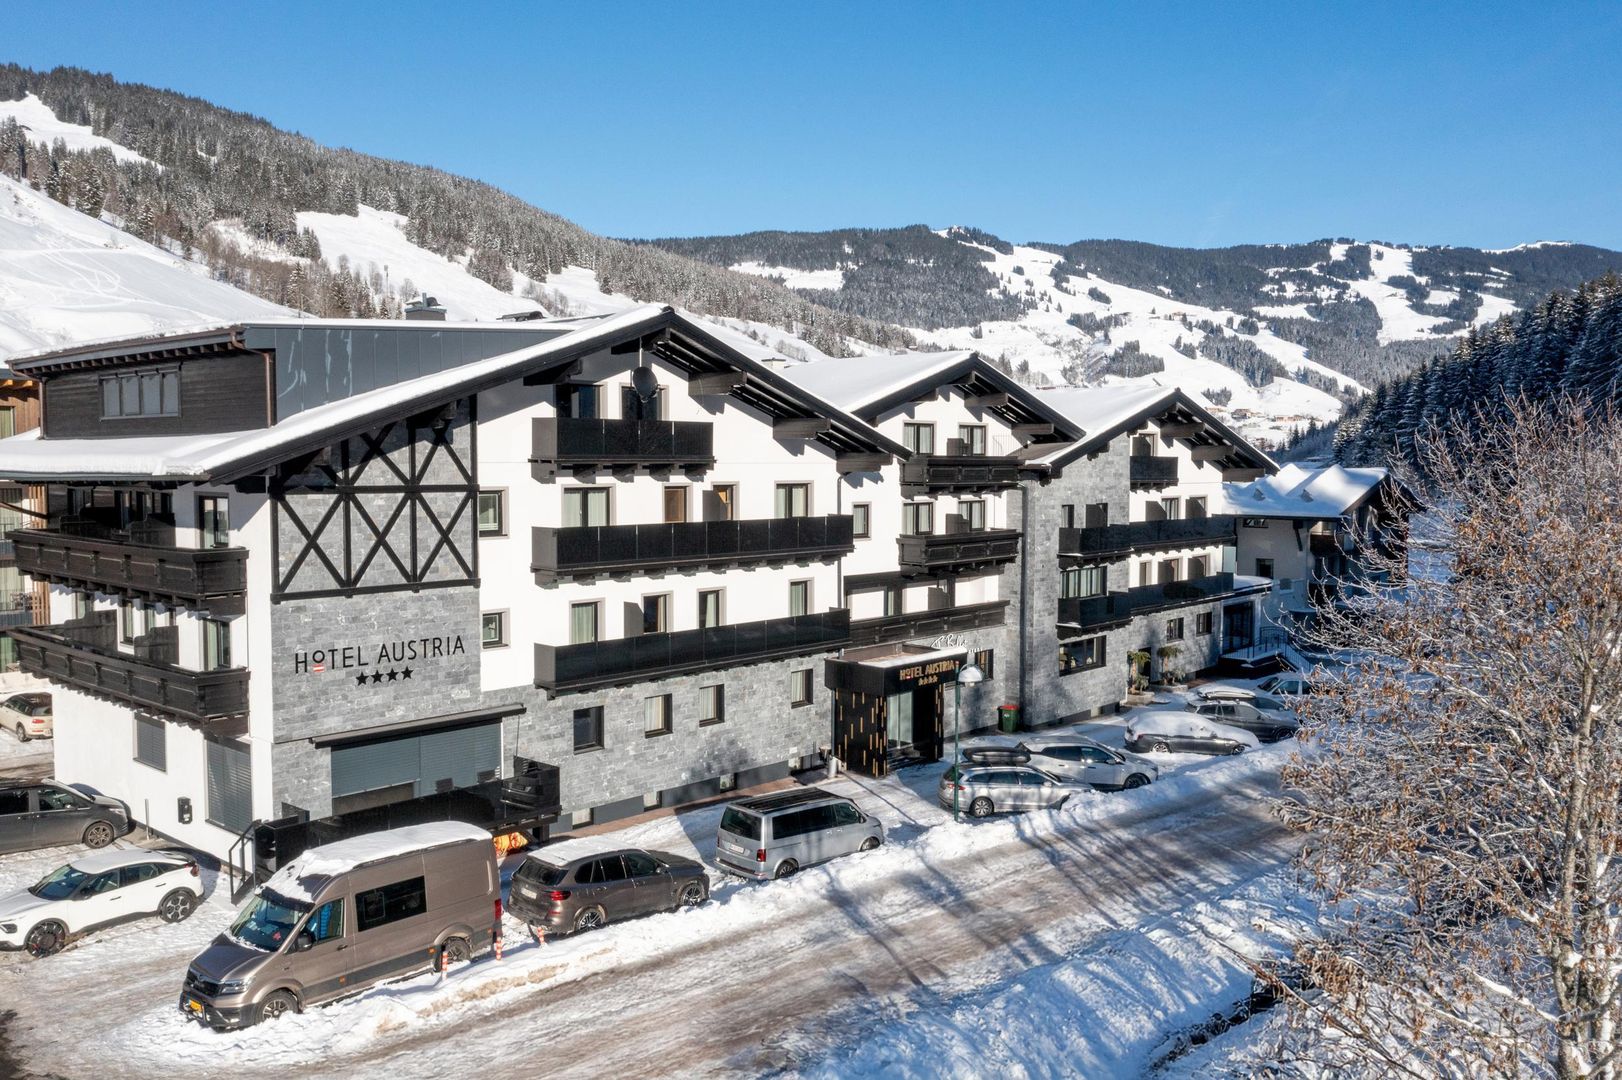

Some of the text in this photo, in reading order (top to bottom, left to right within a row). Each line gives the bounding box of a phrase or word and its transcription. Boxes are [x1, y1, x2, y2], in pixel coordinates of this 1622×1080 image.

[295, 635, 465, 674] HOTEL AUSTRIA
[899, 660, 955, 681] HOTEL AUSTRIA
